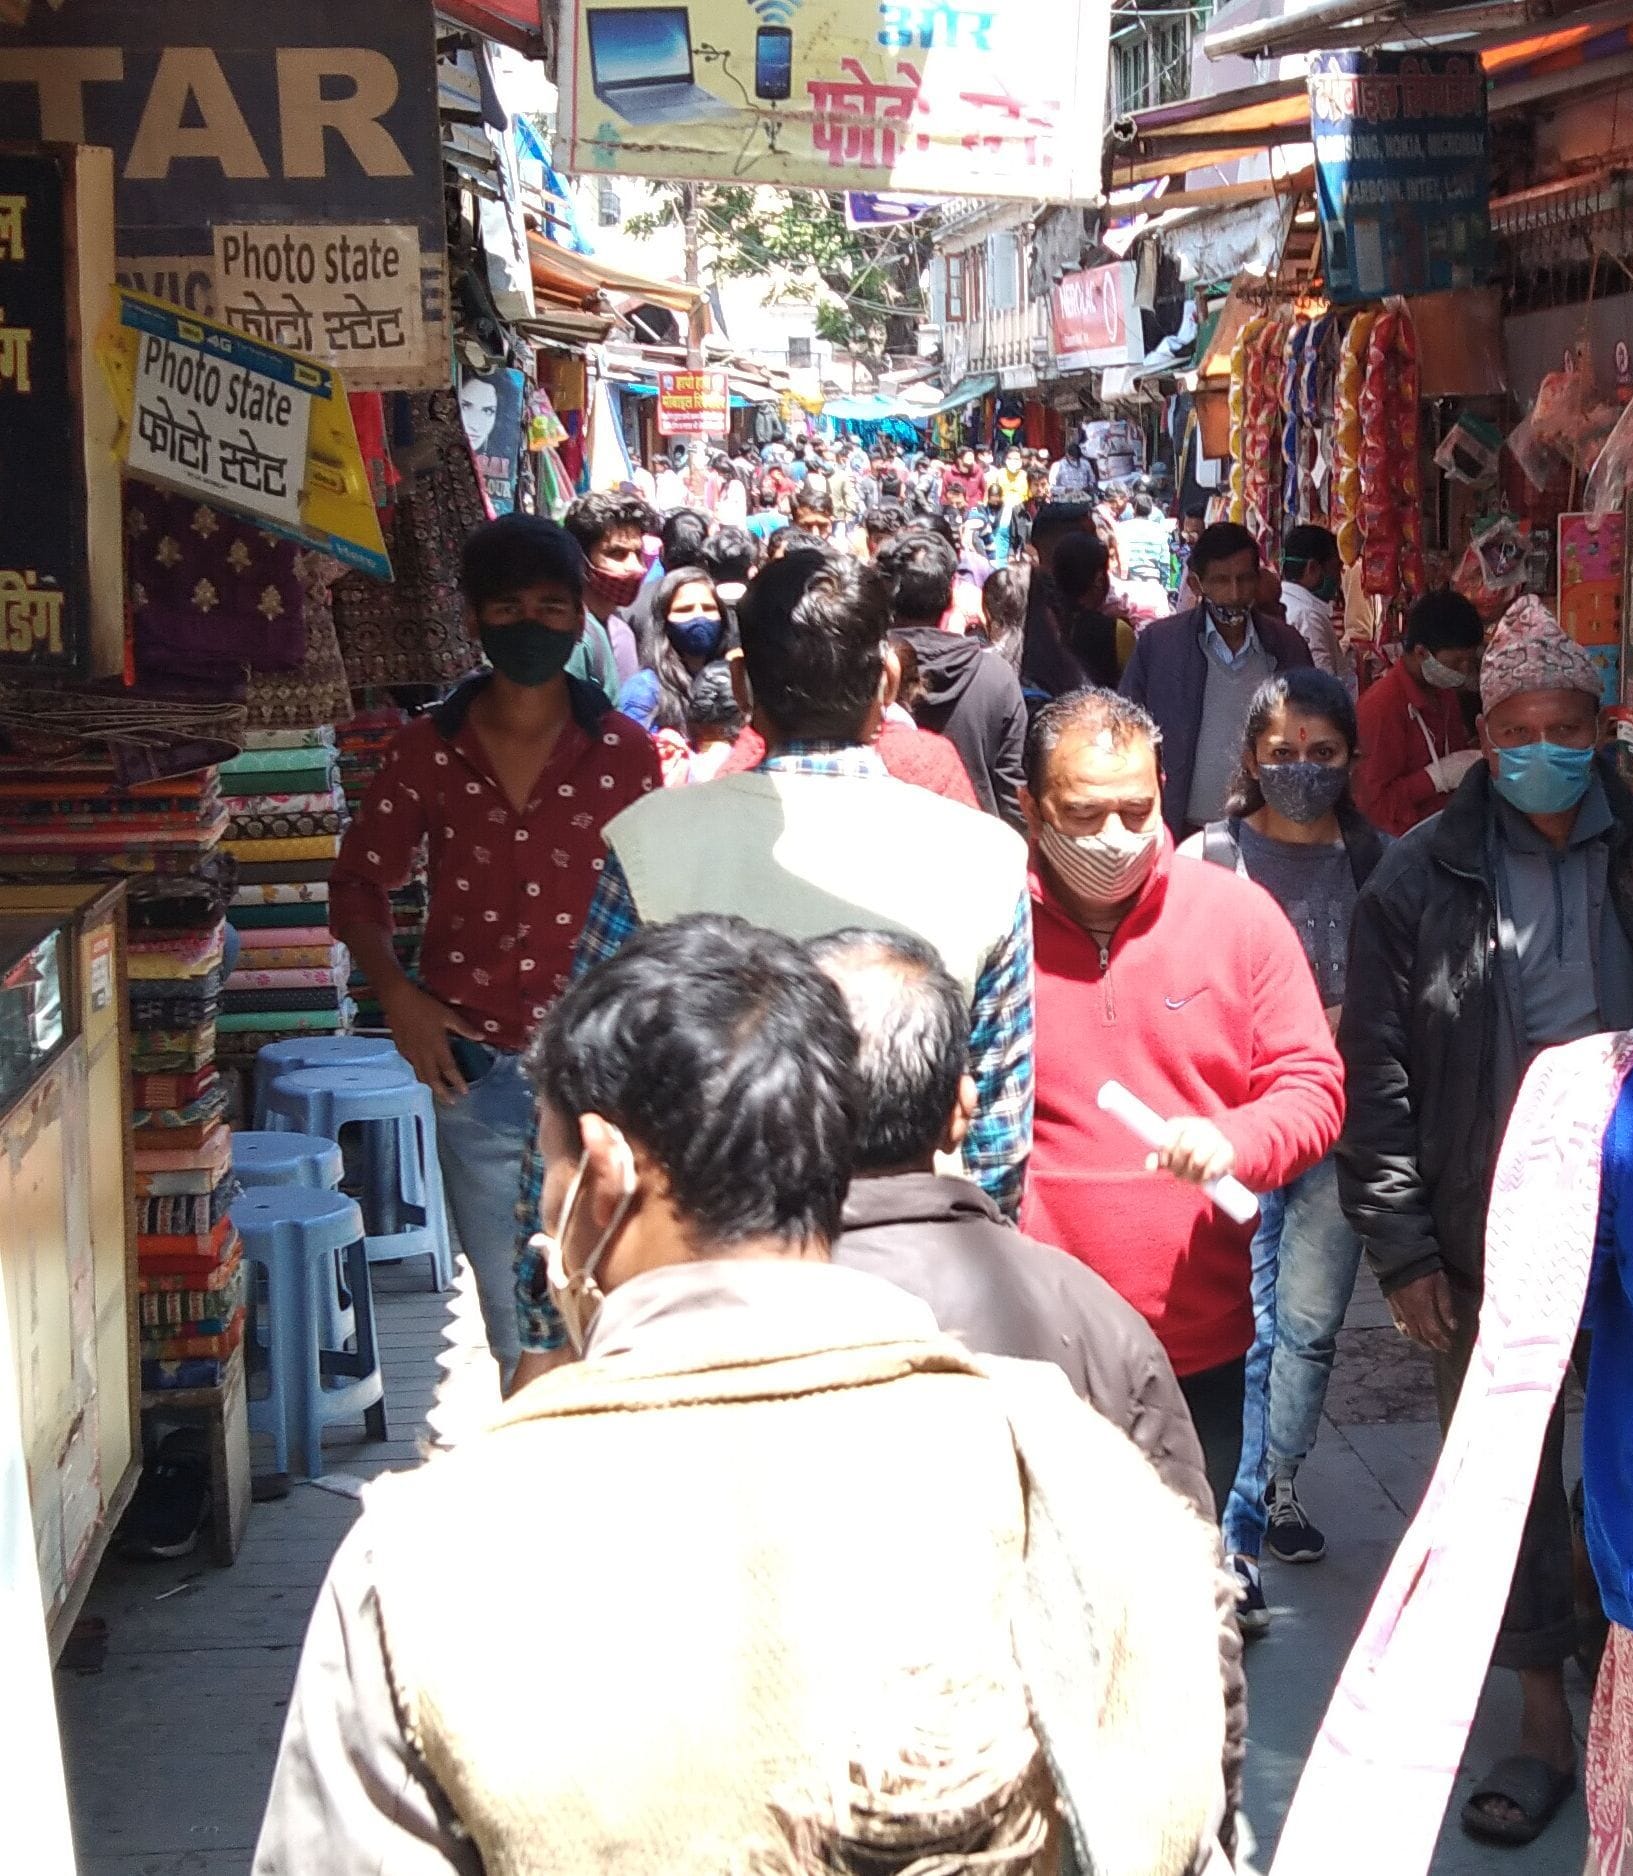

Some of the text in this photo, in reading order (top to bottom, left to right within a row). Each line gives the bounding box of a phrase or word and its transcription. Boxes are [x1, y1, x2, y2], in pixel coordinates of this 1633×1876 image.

[222, 233, 400, 284] Photo state
[225, 290, 406, 351] फोटो स्टेट
[143, 335, 293, 427] Photo state
[138, 396, 288, 498] फोटो स्टेट
